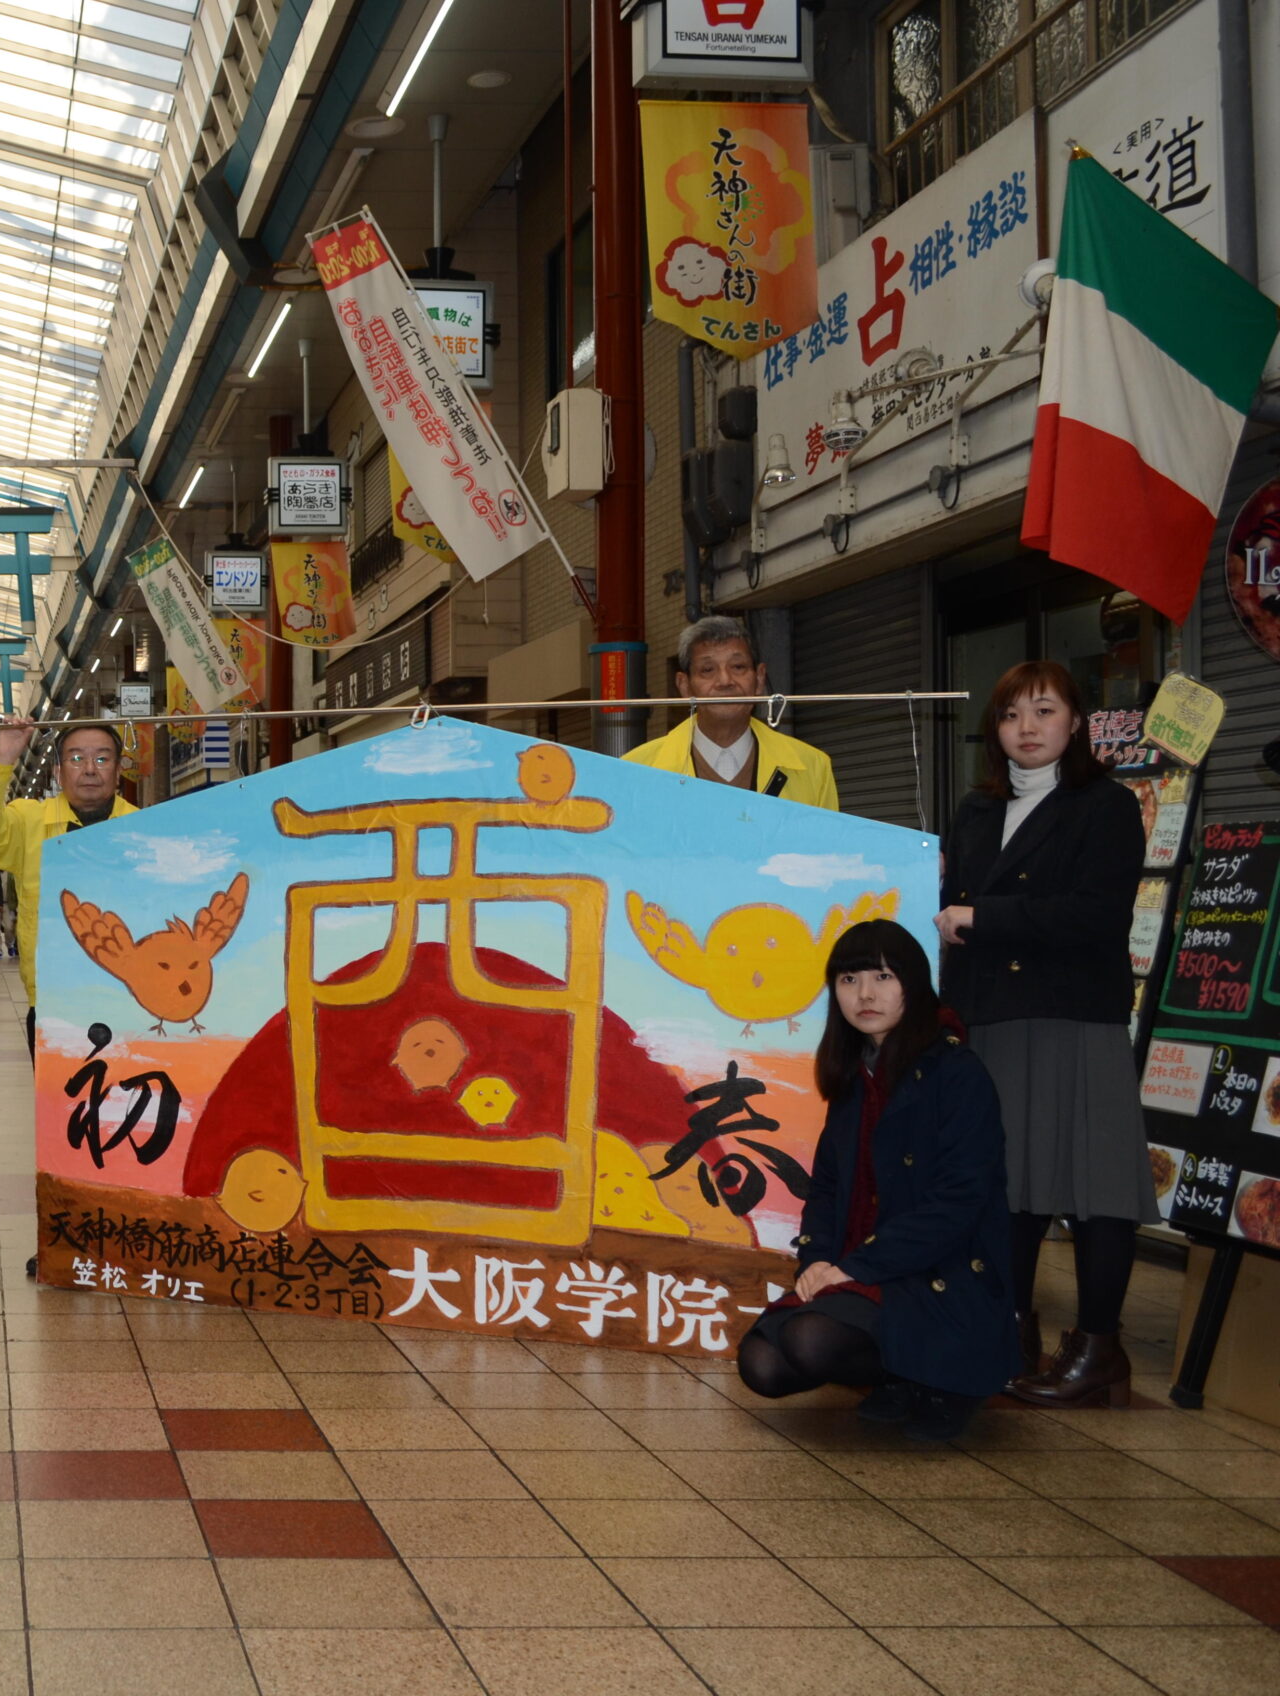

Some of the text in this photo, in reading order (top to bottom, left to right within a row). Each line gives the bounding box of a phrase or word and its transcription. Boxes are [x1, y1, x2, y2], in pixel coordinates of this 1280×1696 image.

[674, 31, 788, 45] TENSAN URANAI YUMEKAN
[705, 42, 756, 54] Fortunetelling
[706, 128, 758, 307] 天神さんの街
[857, 236, 906, 367] 占
[423, 306, 473, 328] 買物は
[700, 315, 781, 342] てんさん
[286, 496, 334, 509] 陶器店
[287, 483, 333, 496] あらき
[215, 571, 258, 588] エンドソン
[1203, 853, 1250, 882] サラダ
[1181, 928, 1232, 949] お飲みもの
[1197, 978, 1251, 1012] ¥1590
[1223, 1066, 1257, 1091] 本日の
[63, 1022, 183, 1169] 初
[1209, 1089, 1242, 1116] パスタ
[649, 1059, 813, 1217] 春
[1196, 1156, 1233, 1188] 自家製
[1175, 1184, 1223, 1217] ミートソース
[48, 1208, 392, 1290] 天神橋筋商店連合会
[71, 1256, 206, 1302] 笠松 オリエ
[387, 1246, 776, 1352] 大阪学院
